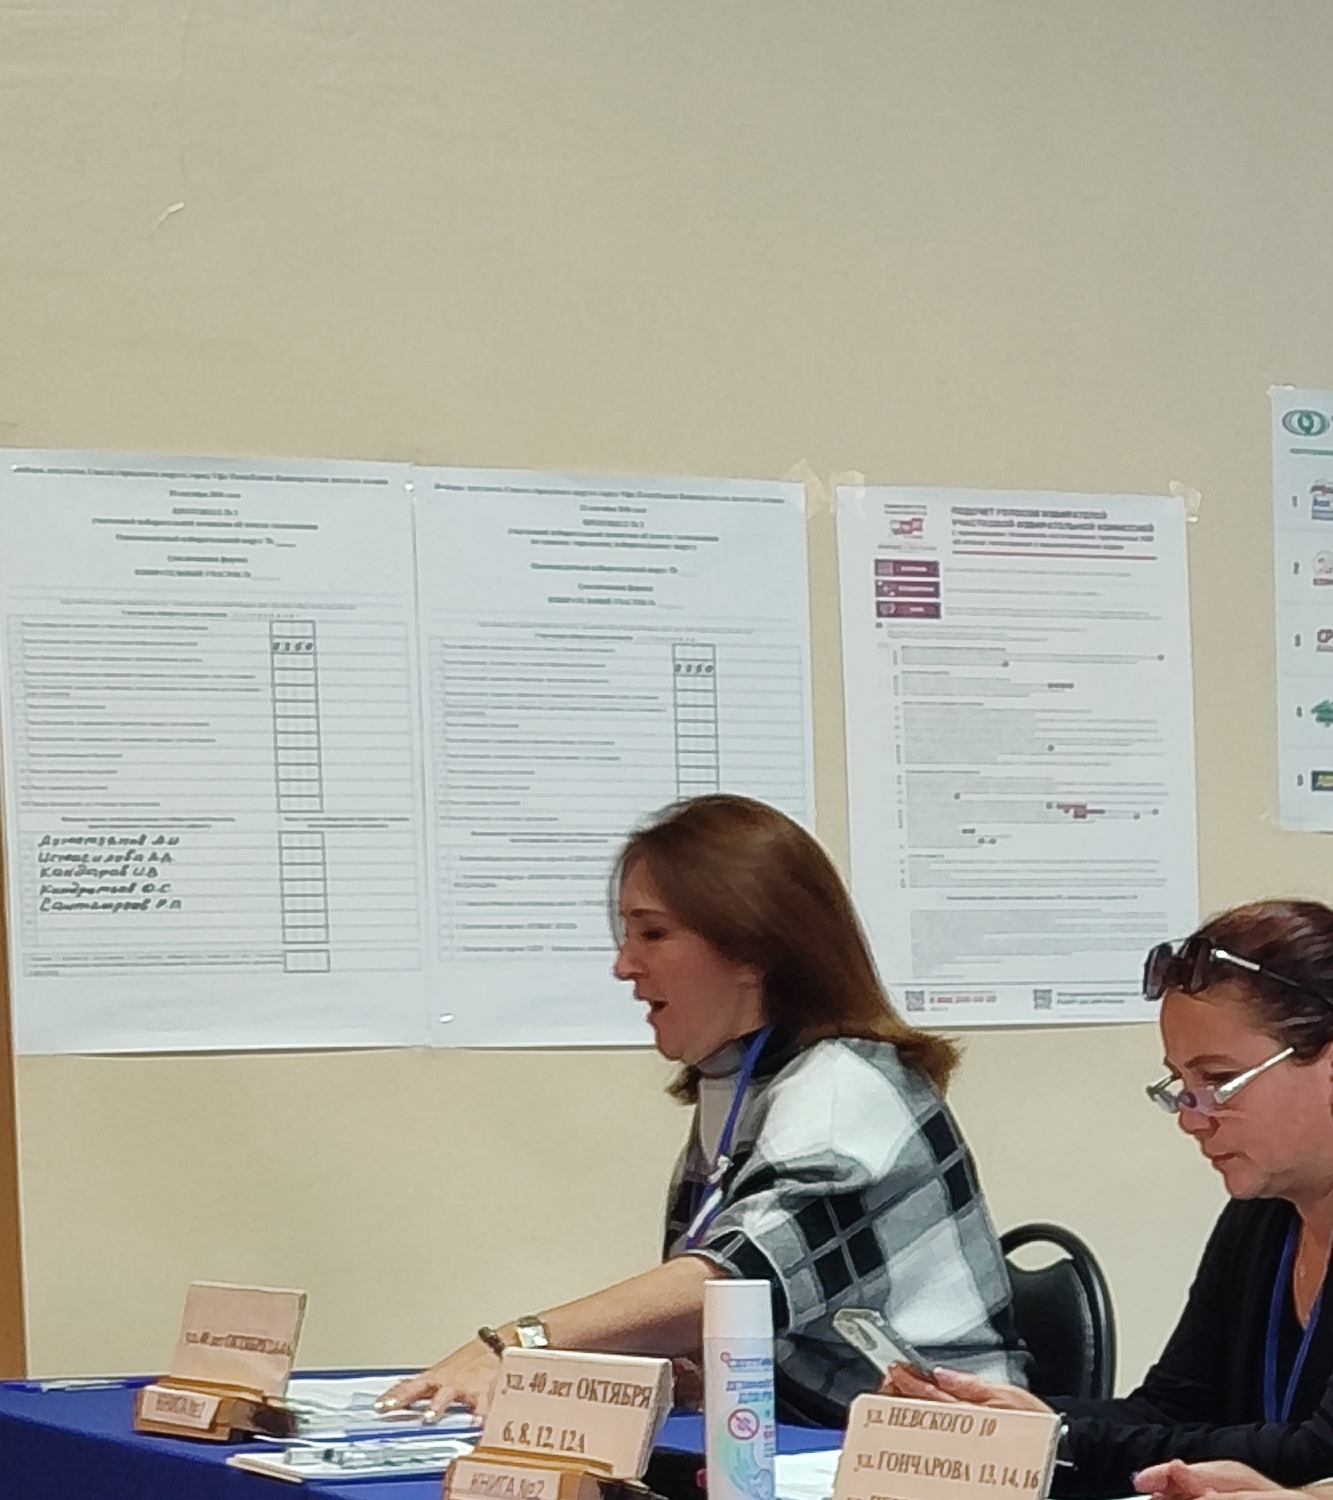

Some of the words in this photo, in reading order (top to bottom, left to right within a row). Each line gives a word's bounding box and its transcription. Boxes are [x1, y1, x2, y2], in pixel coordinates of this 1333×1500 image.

[502, 1373, 524, 1394] ул.
[529, 1372, 547, 1394] 40
[548, 1381, 572, 1398] лет
[577, 1378, 652, 1409] ОКТЯБРЯ
[889, 1407, 974, 1434] НЕВСКОГО
[979, 1418, 997, 1437] 10
[560, 1429, 585, 1453] 12А
[877, 1451, 971, 1482] ГОНЧАРОВА
[1022, 1470, 1041, 1489] 16
